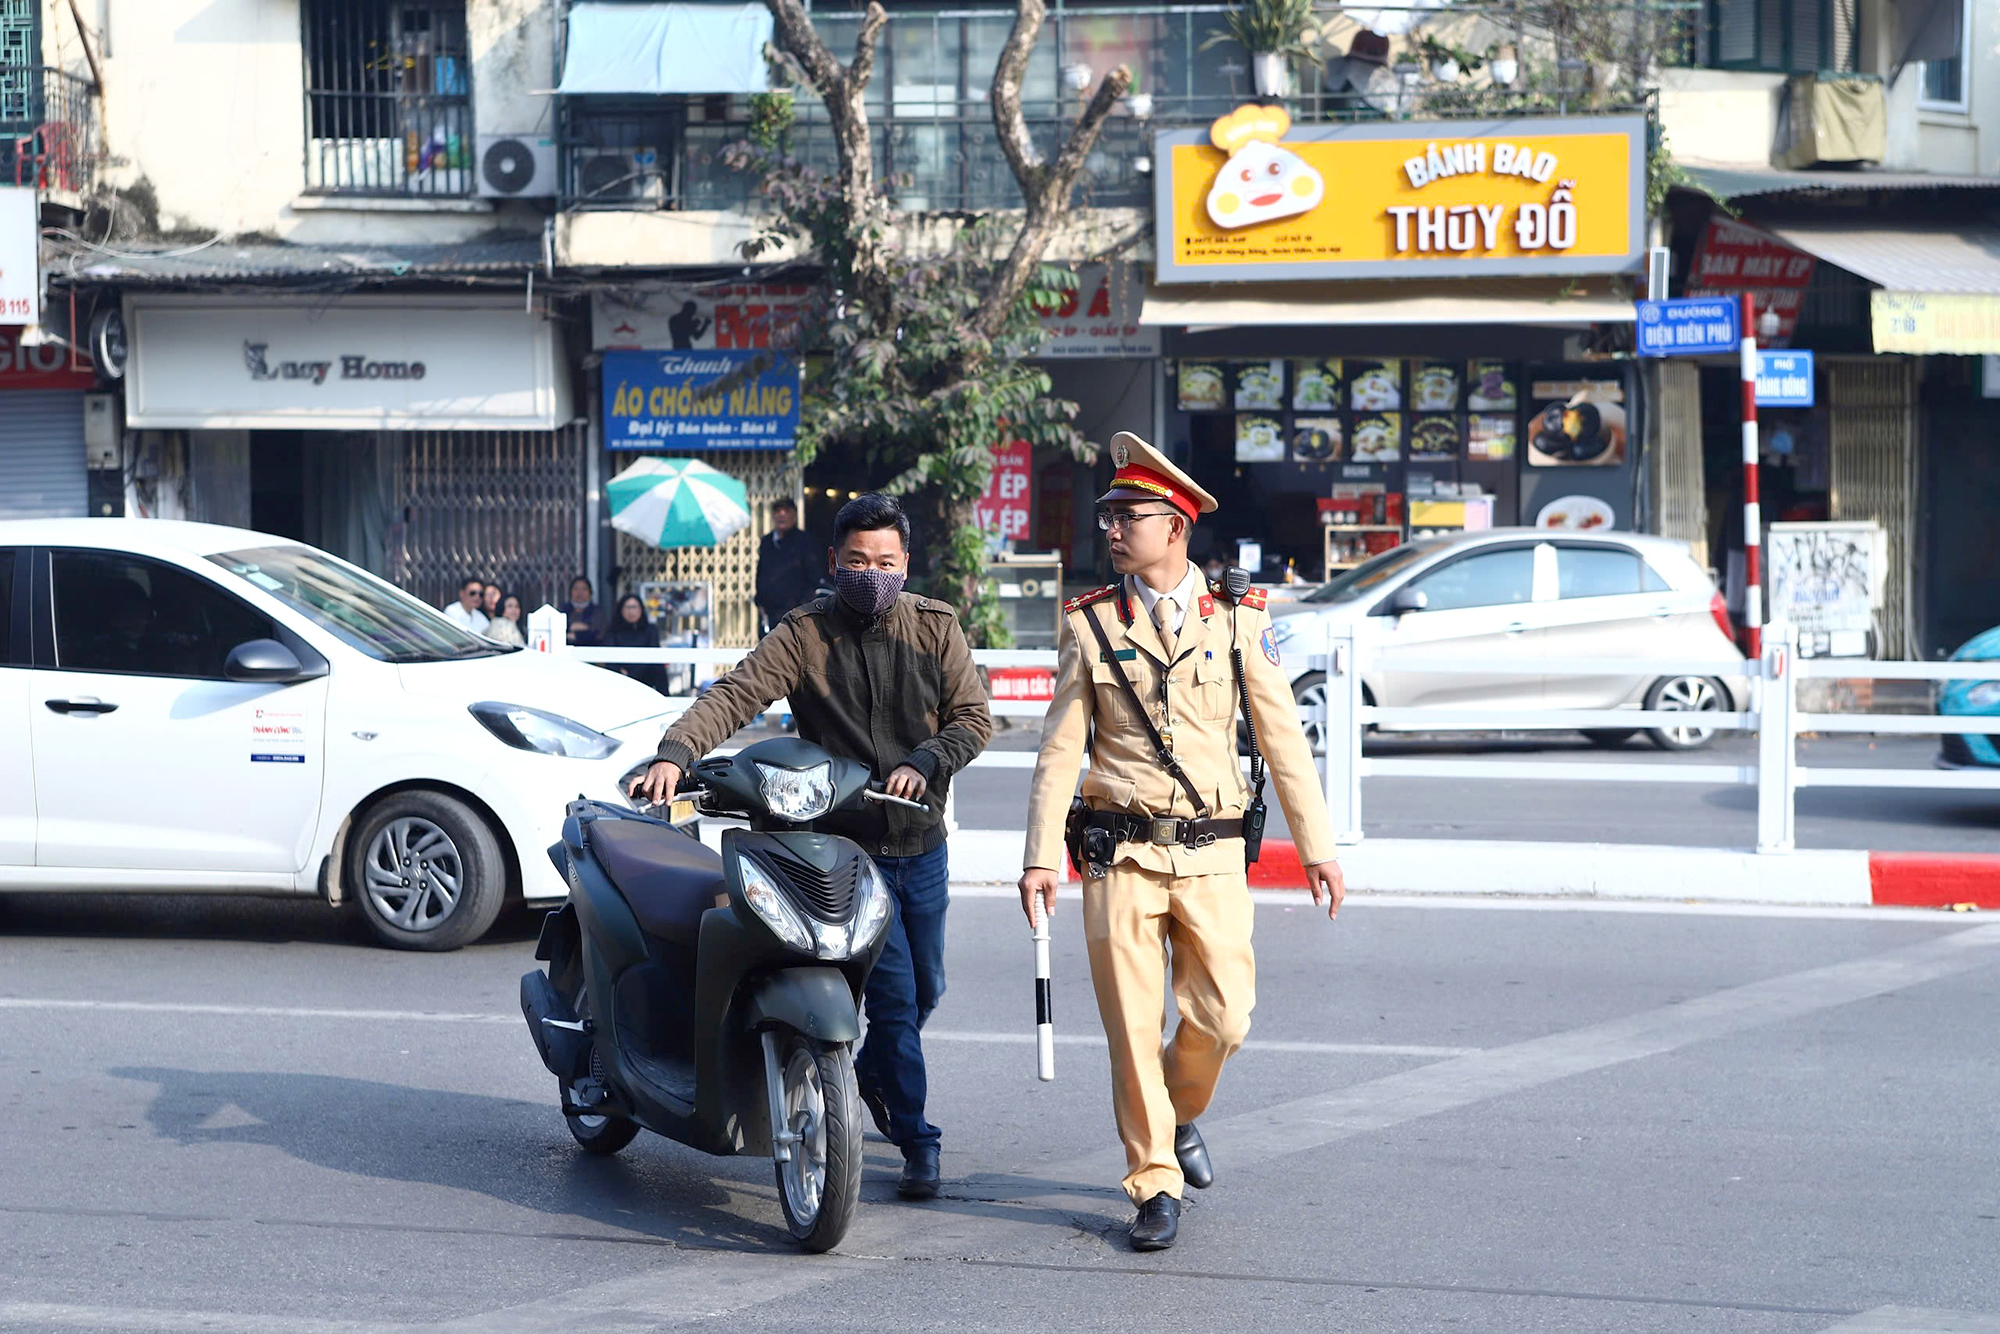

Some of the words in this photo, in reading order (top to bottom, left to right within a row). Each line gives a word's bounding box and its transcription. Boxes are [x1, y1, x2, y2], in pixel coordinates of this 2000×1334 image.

[1404, 142, 1486, 188] BÁNH
[1493, 143, 1558, 183] BAO
[1515, 178, 1576, 249] ĐỖ
[10, 299, 30, 314] 115
[1667, 305, 1723, 319] ĐƯỜNG
[1676, 322, 1704, 344] BIÊN
[1707, 316, 1732, 342] PHỦ
[341, 354, 426, 380] Home
[612, 380, 645, 417] ÁO
[999, 467, 1029, 499] ÉP
[999, 503, 1029, 535] ÉP
